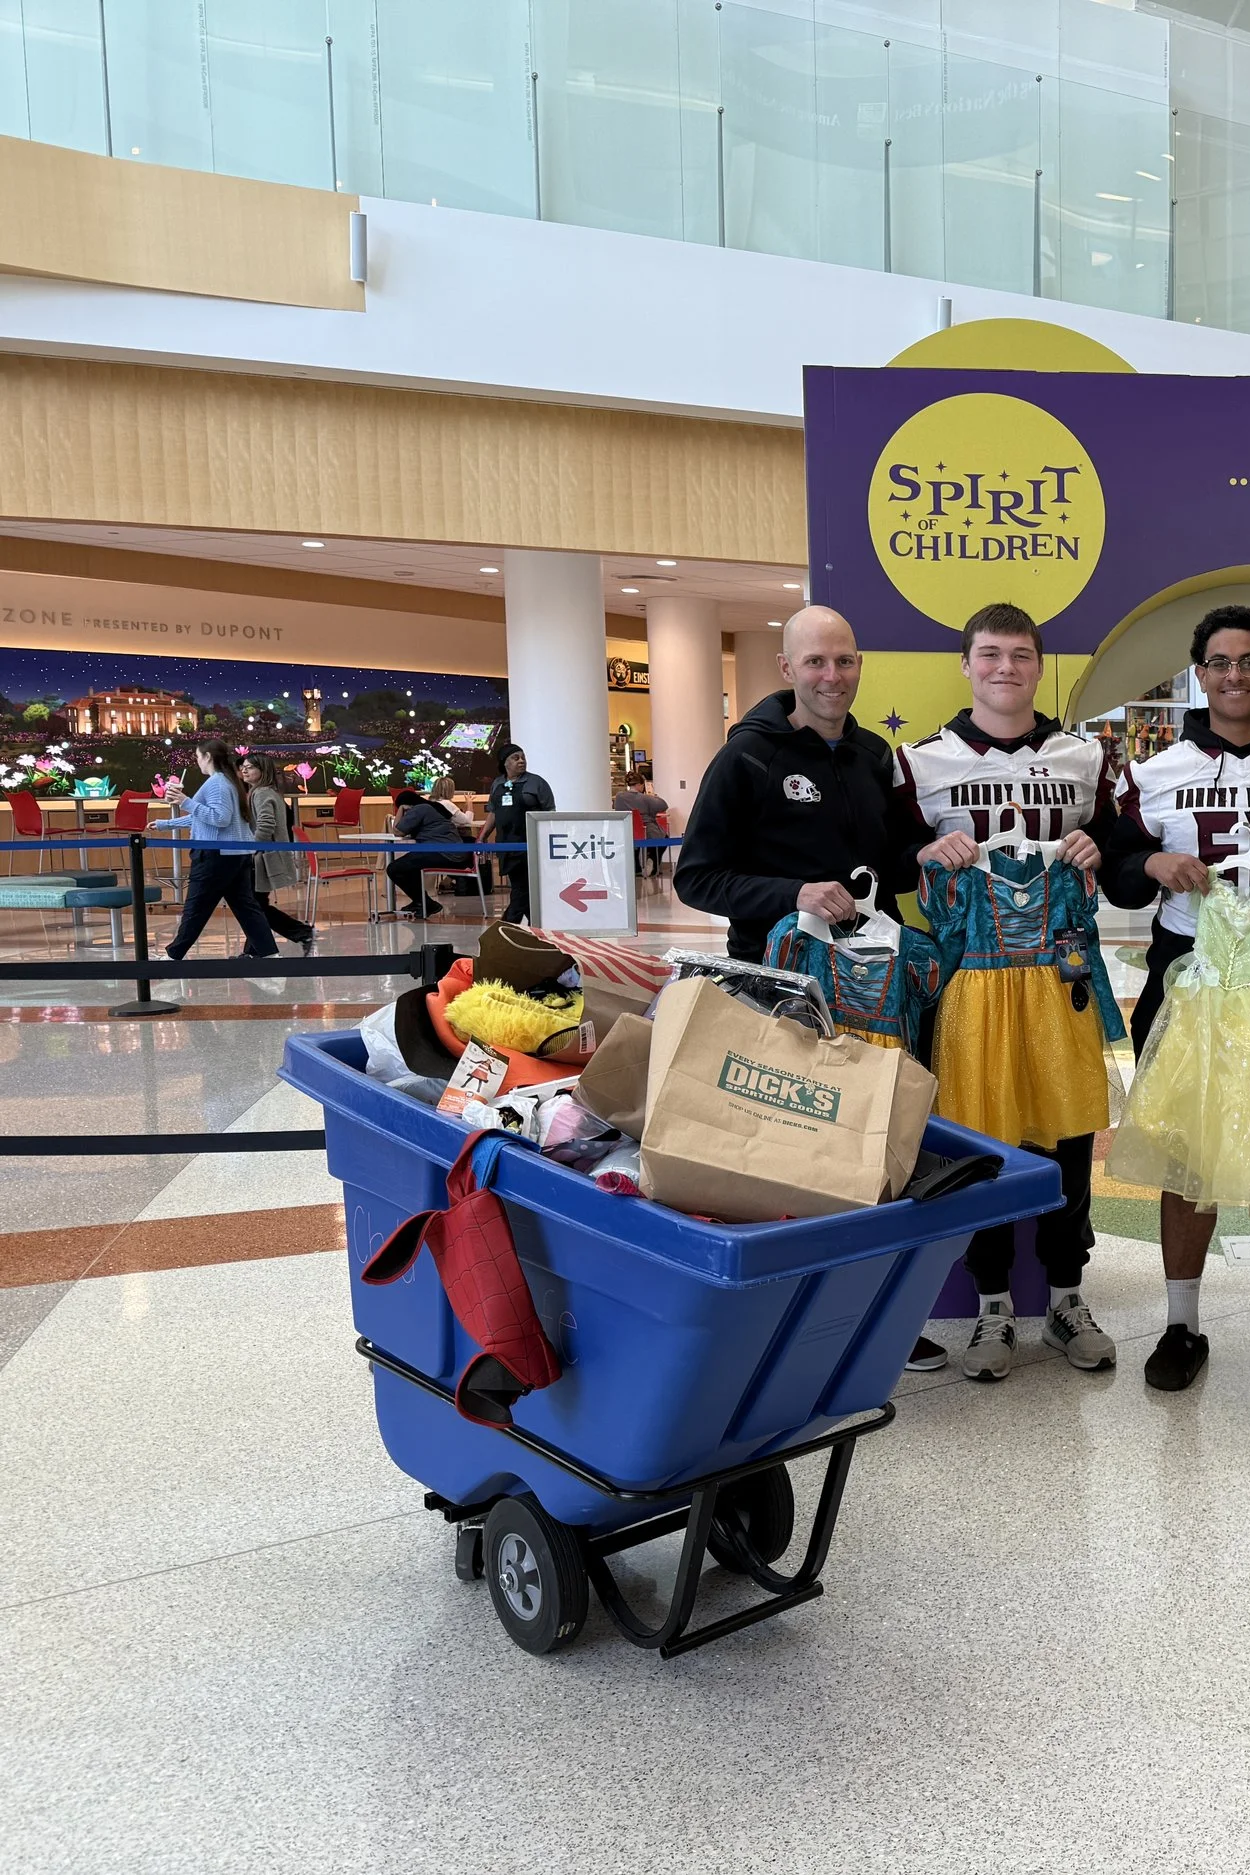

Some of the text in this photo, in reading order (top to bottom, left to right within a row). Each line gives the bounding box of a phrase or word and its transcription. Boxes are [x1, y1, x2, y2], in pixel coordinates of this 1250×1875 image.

[888, 463, 1081, 528] SPIRIT
[918, 518, 938, 531] OF
[889, 530, 1081, 561] CHILDREN
[2, 607, 284, 641] ZONE PRESENTED BY DUPONT
[1021, 783, 1076, 805] VALLEY
[548, 834, 616, 860] Exit
[727, 1050, 756, 1065] EVERY
[757, 1061, 795, 1078] SEASON
[796, 1074, 830, 1089] STARTS
[725, 1060, 835, 1112] DICK'S
[725, 1083, 786, 1106] SPORTING
[728, 1101, 744, 1112] SHOP
[744, 1107, 753, 1115] US
[753, 1111, 773, 1122] ONLINE
[782, 1119, 819, 1132] DICKS.COM
